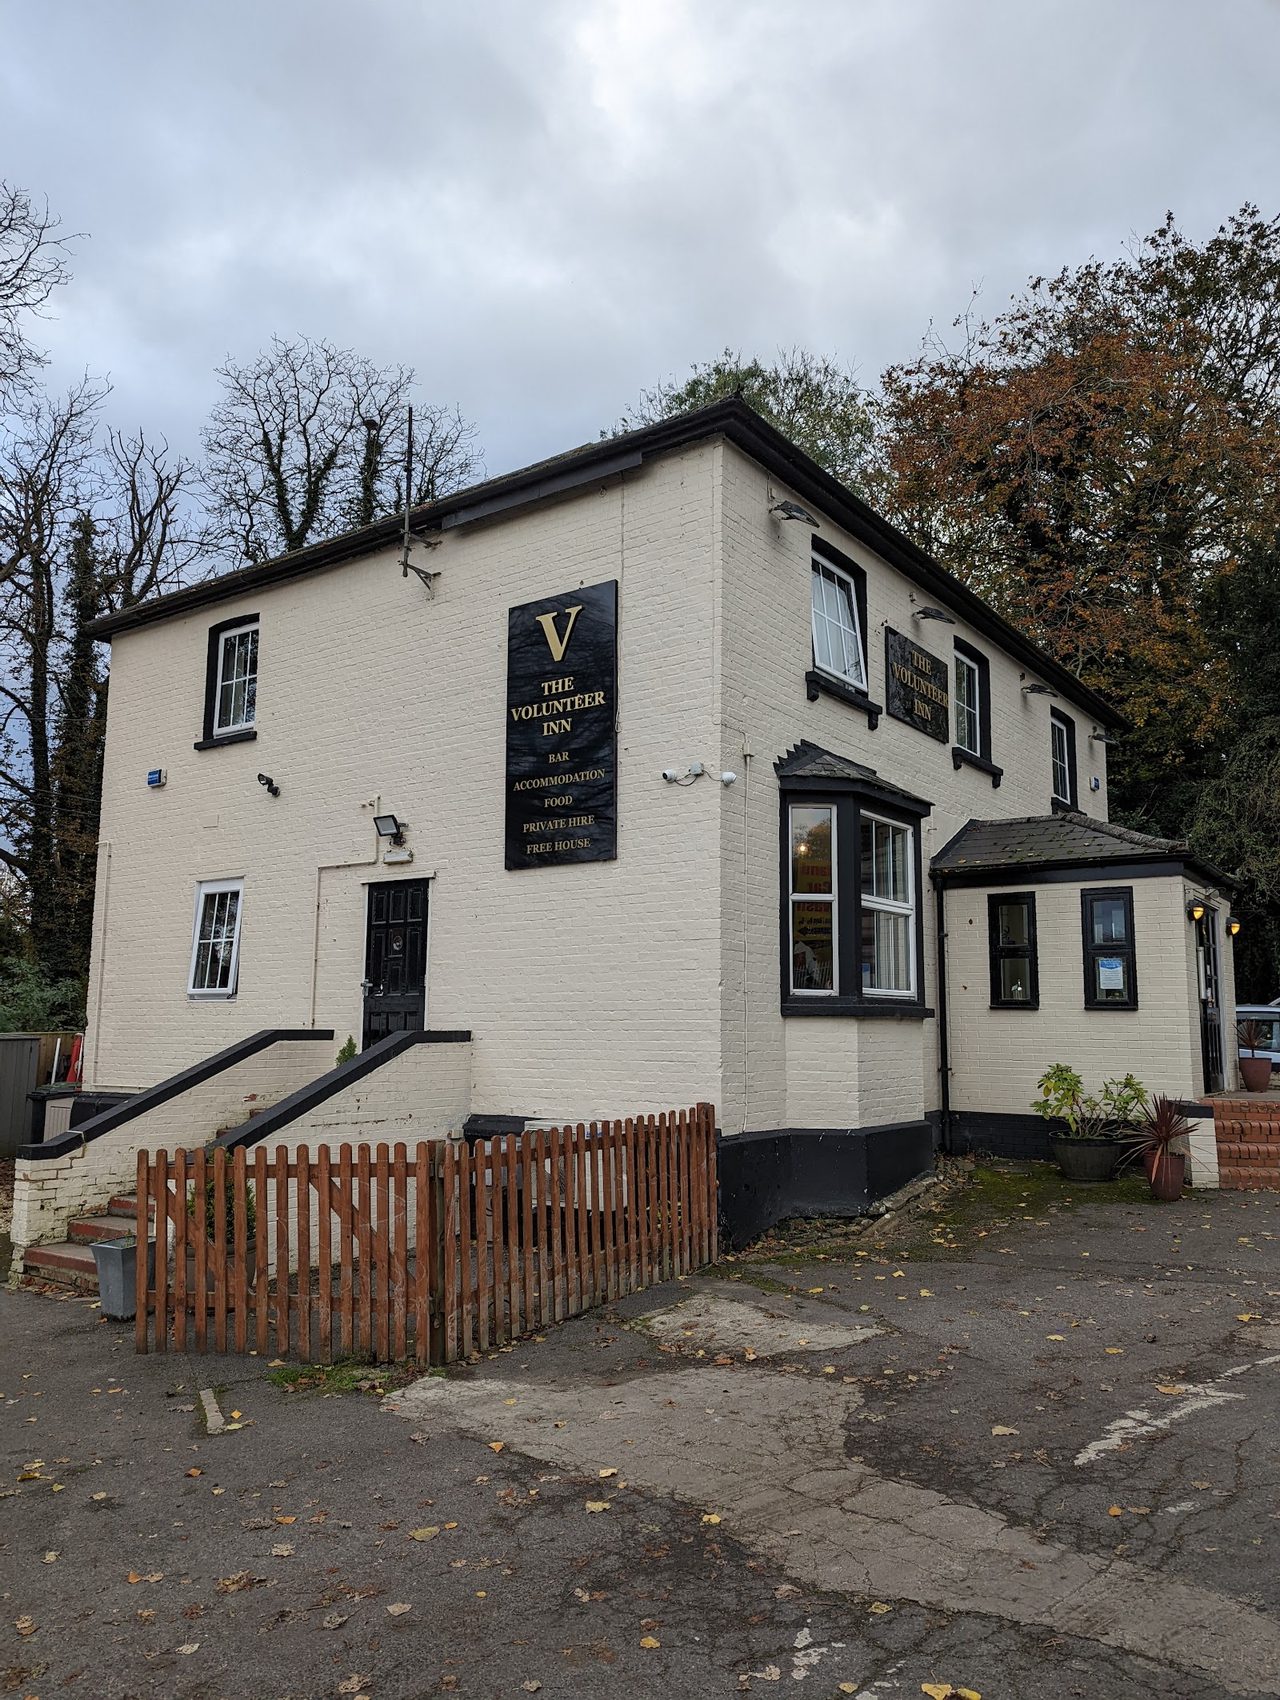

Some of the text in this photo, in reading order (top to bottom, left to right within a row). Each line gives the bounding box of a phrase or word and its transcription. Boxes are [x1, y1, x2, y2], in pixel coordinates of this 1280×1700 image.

[535, 605, 583, 662] V
[911, 649, 932, 676] THE
[541, 676, 575, 696] THE
[891, 661, 949, 708] VOLUNTEER
[510, 691, 606, 721] VOLUNTEER
[913, 698, 932, 721] INN
[542, 717, 573, 737] INN
[548, 751, 570, 764] BAR
[513, 769, 605, 791] ACCOMMODATION
[543, 795, 573, 808] FOOD
[523, 815, 595, 832] PRIVATE HIRE
[526, 838, 591, 854] FREE HOUSE
